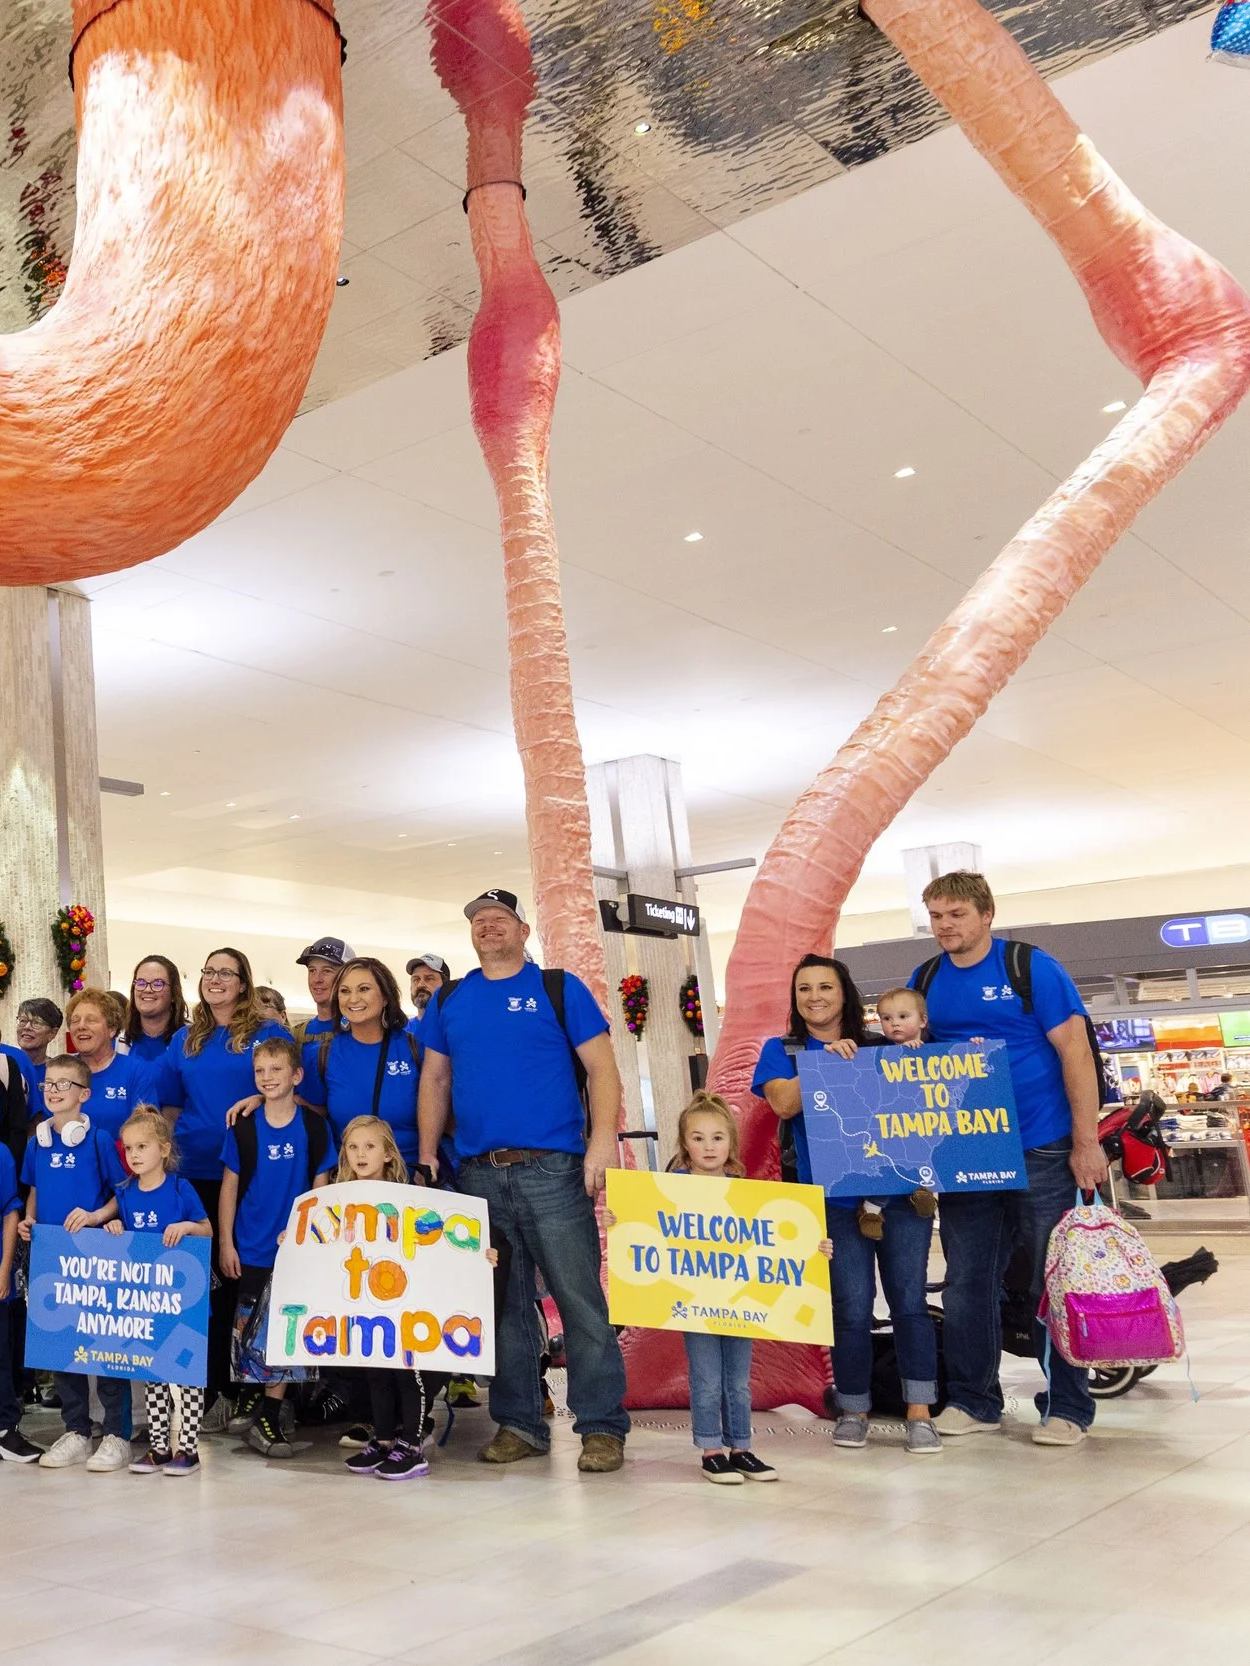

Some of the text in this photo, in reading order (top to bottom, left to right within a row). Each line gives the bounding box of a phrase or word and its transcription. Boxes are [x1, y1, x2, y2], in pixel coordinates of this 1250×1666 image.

[645, 903, 675, 923] Ticketing
[880, 1053, 988, 1083] WELCOME
[920, 1082, 950, 1109] TO
[875, 1107, 1011, 1138] TAMPA BAY!
[967, 1171, 1017, 1180] TAMPA BAY
[295, 1196, 482, 1261] Tampa
[657, 1210, 776, 1247] WELCOME
[58, 1255, 174, 1287] YOU'RE NOT IN
[343, 1246, 408, 1301] to
[630, 1244, 805, 1287] TO TAMPA BAY
[54, 1282, 182, 1315] TAMPA, KANSAS
[76, 1312, 154, 1341] ANYMORE
[691, 1306, 768, 1323] TAMPA BAY
[713, 1321, 747, 1329] FLORIDA
[280, 1303, 483, 1368] Tampa
[90, 1350, 154, 1367] TAMPA BAY
[107, 1365, 135, 1373] FLORIDA
[414, 1369, 426, 1394] ARM
